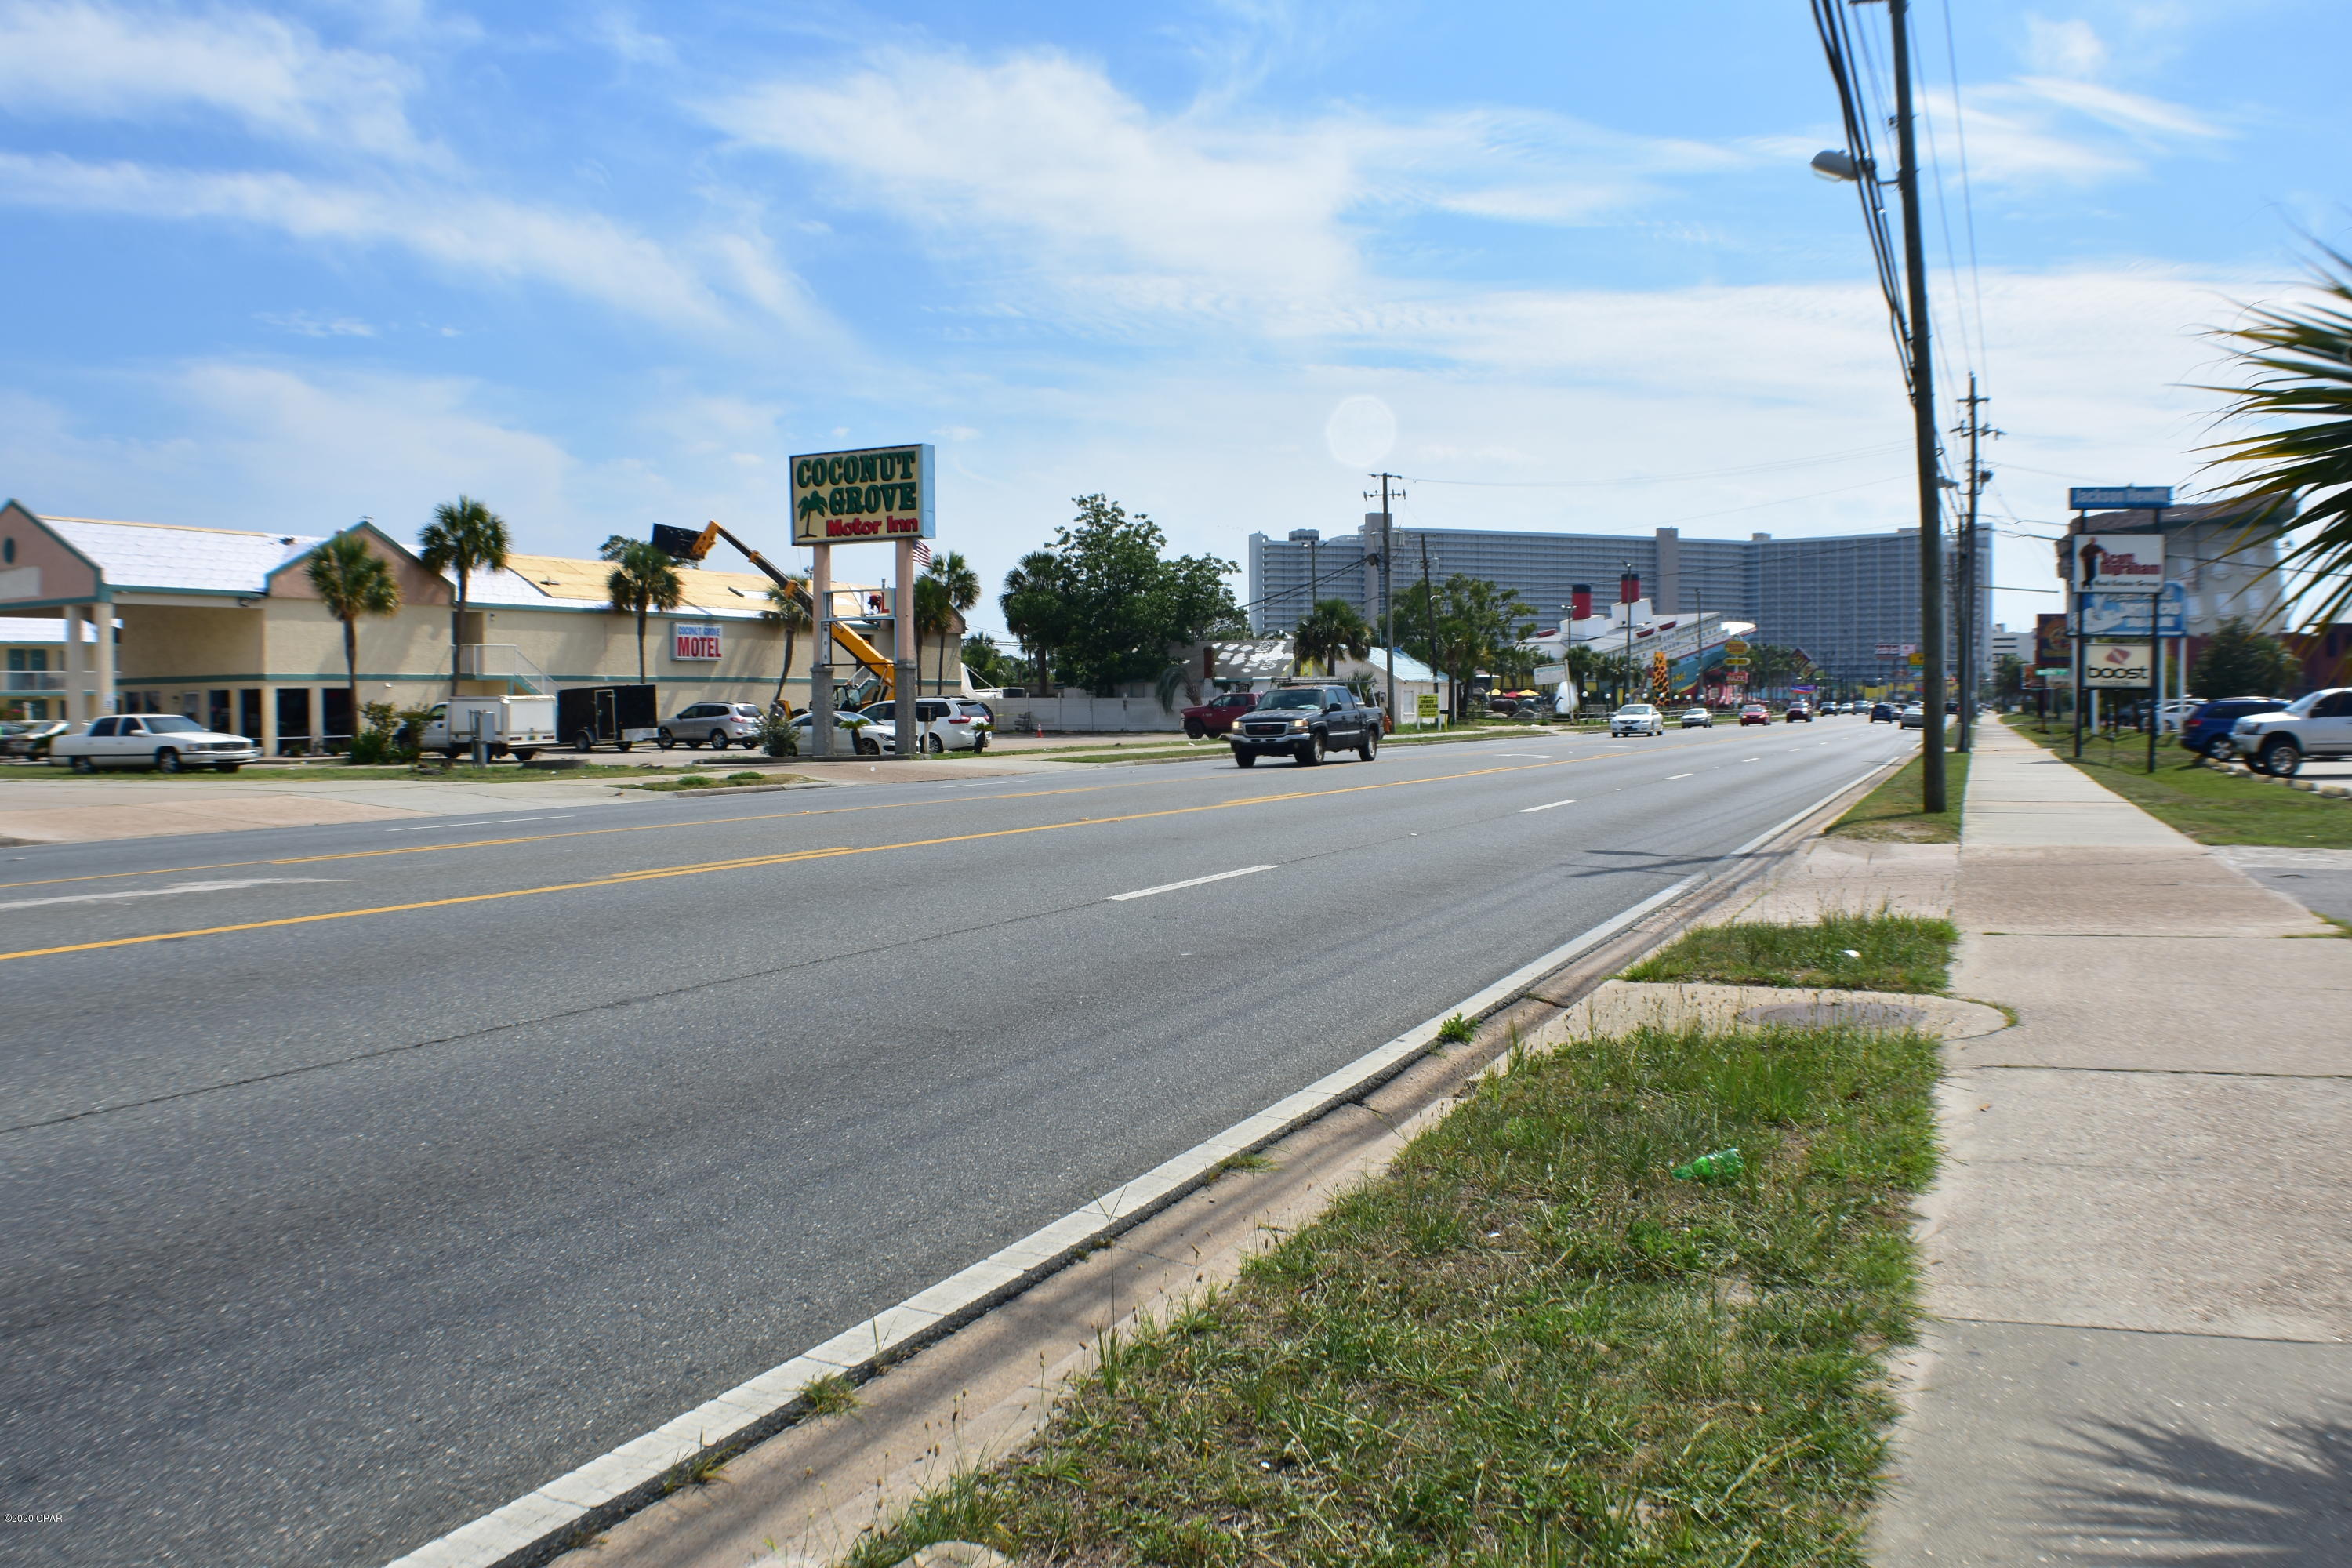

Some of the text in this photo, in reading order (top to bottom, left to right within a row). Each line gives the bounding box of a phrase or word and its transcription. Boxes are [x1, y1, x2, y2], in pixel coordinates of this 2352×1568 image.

[797, 451, 916, 488] COCONUT
[829, 481, 916, 516] GROVE
[826, 515, 918, 537] Motor Inn
[677, 636, 722, 657] MOTEL
[2087, 665, 2149, 679] boost
